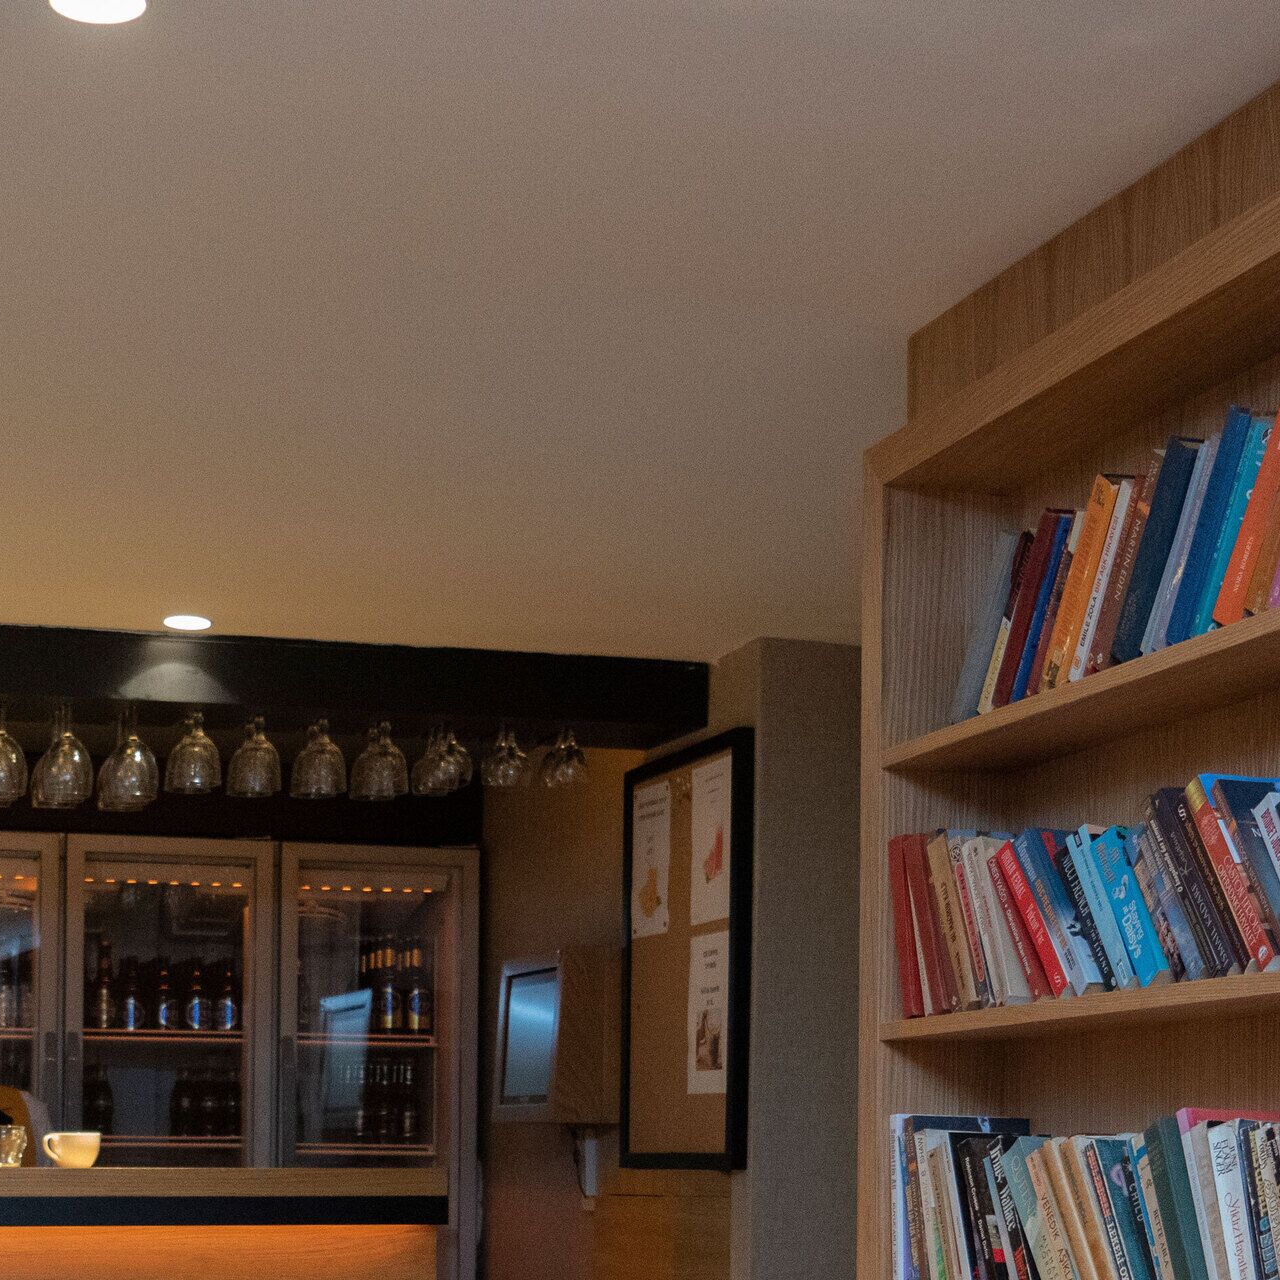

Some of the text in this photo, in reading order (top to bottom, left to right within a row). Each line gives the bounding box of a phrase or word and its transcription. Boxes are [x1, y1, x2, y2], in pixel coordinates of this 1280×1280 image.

[1112, 519, 1142, 601] MARTIN EDEN
[1239, 536, 1254, 570] ROBERTS
[1087, 595, 1098, 618] ZOLA
[1060, 854, 1077, 880] NICCI
[1070, 880, 1090, 917] FRENCH
[1092, 942, 1109, 974] LIVING
[1190, 881, 1214, 926] KADARE
[962, 1156, 976, 1187] Robinson
[968, 1187, 980, 1211] Crusoe
[1000, 1187, 1017, 1232] Wallace
